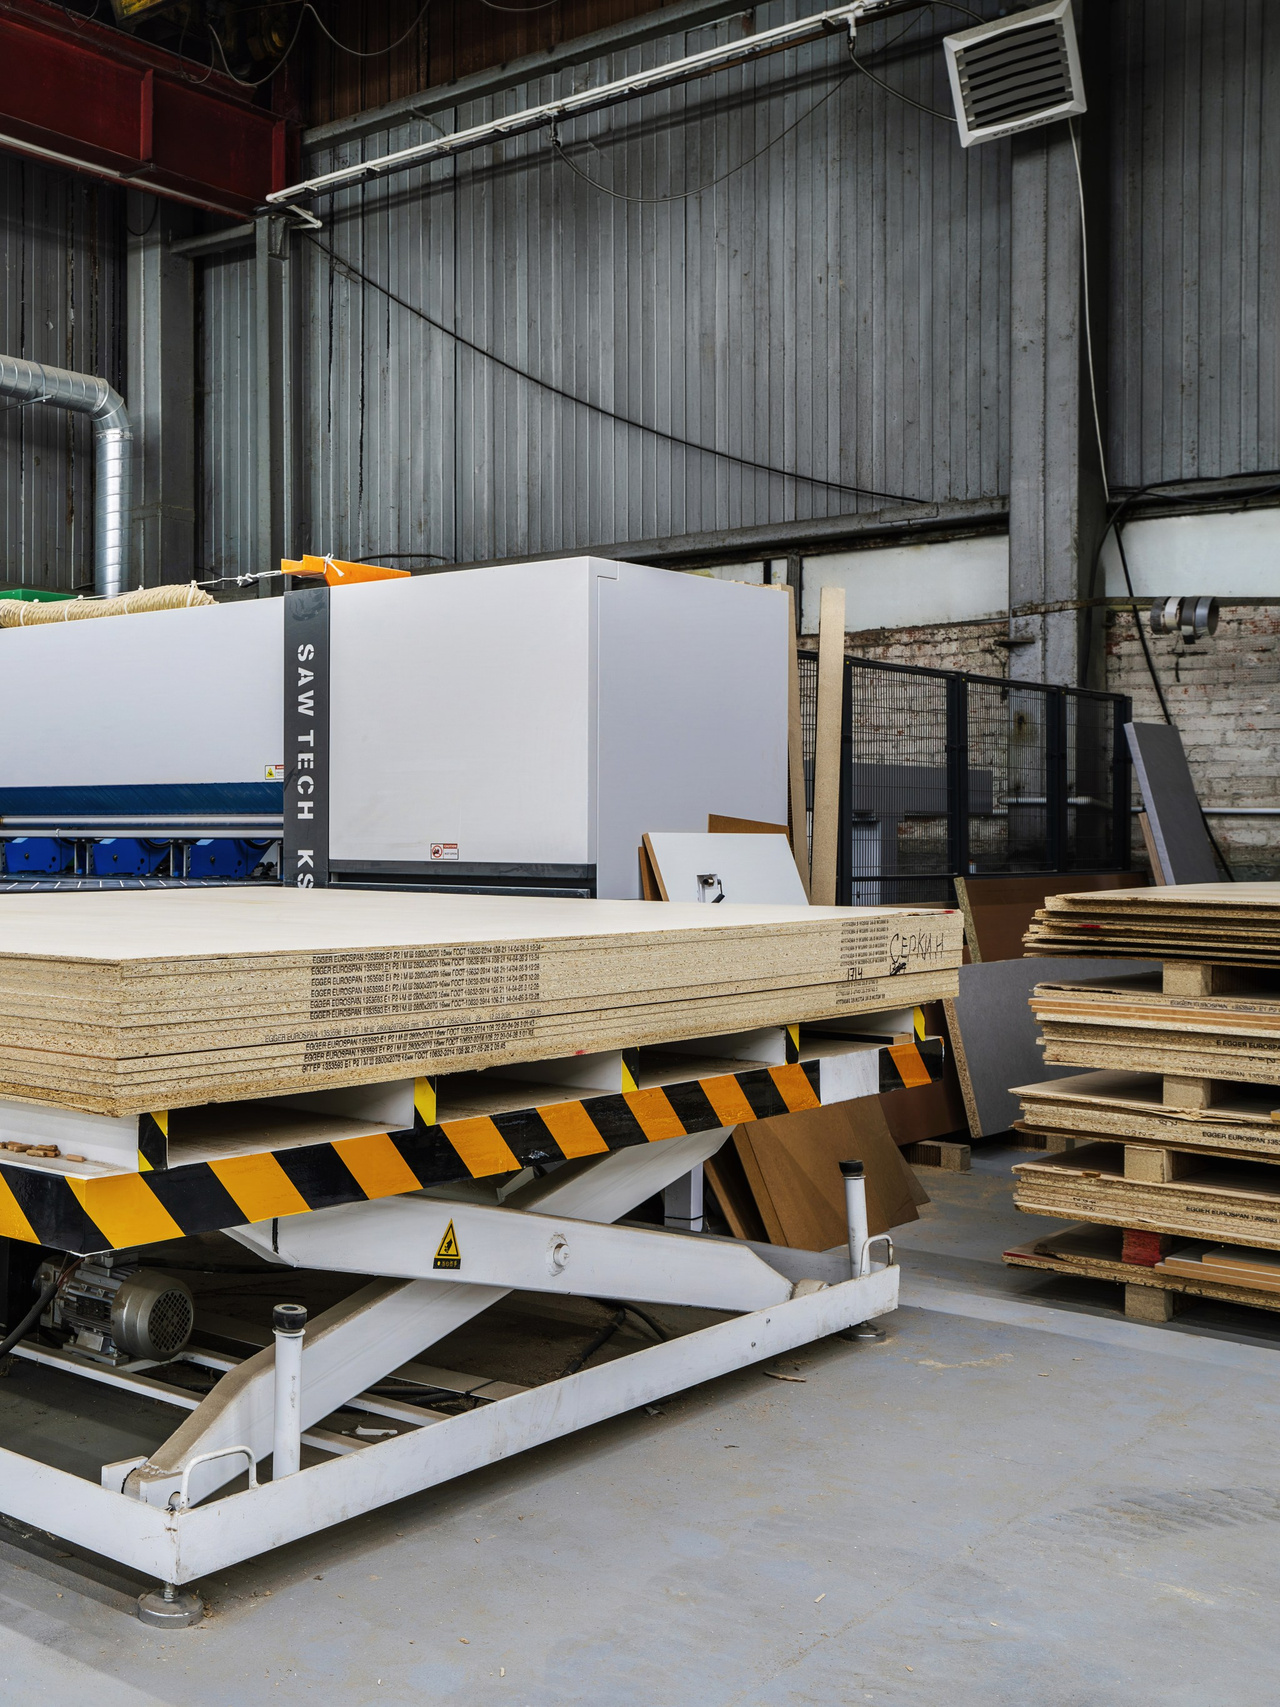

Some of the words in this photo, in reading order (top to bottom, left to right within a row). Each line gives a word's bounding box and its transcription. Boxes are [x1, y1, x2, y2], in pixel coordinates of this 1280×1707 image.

[992, 116, 1055, 137] VOLCANO
[297, 644, 314, 716] SAW
[297, 729, 314, 819] TECH
[312, 955, 332, 963] EGGER
[333, 953, 363, 962] EUROSPAN
[311, 966, 331, 974] EGGER
[332, 964, 362, 973] EUROSPAN
[311, 978, 331, 986] EGGER
[332, 975, 362, 985] EUROSPAN
[310, 989, 331, 997] EGGER
[332, 986, 362, 996] EUROSPAN
[310, 999, 330, 1008] EGGER
[331, 997, 361, 1006] EUROSPAN
[310, 1010, 330, 1019] EGGER
[331, 1008, 361, 1017] EUROSPAN
[305, 1041, 326, 1051] EGGER
[327, 1038, 357, 1048] EUROSPAN
[1223, 1040, 1247, 1048] EGGER
[304, 1052, 324, 1062] EGGER
[326, 1049, 355, 1059] EUROSPAN
[1202, 1131, 1227, 1139] EGGER
[1228, 1134, 1266, 1144] EUROSPAN
[1186, 1206, 1210, 1214] EGGER
[1211, 1210, 1249, 1219] EUROSPAN
